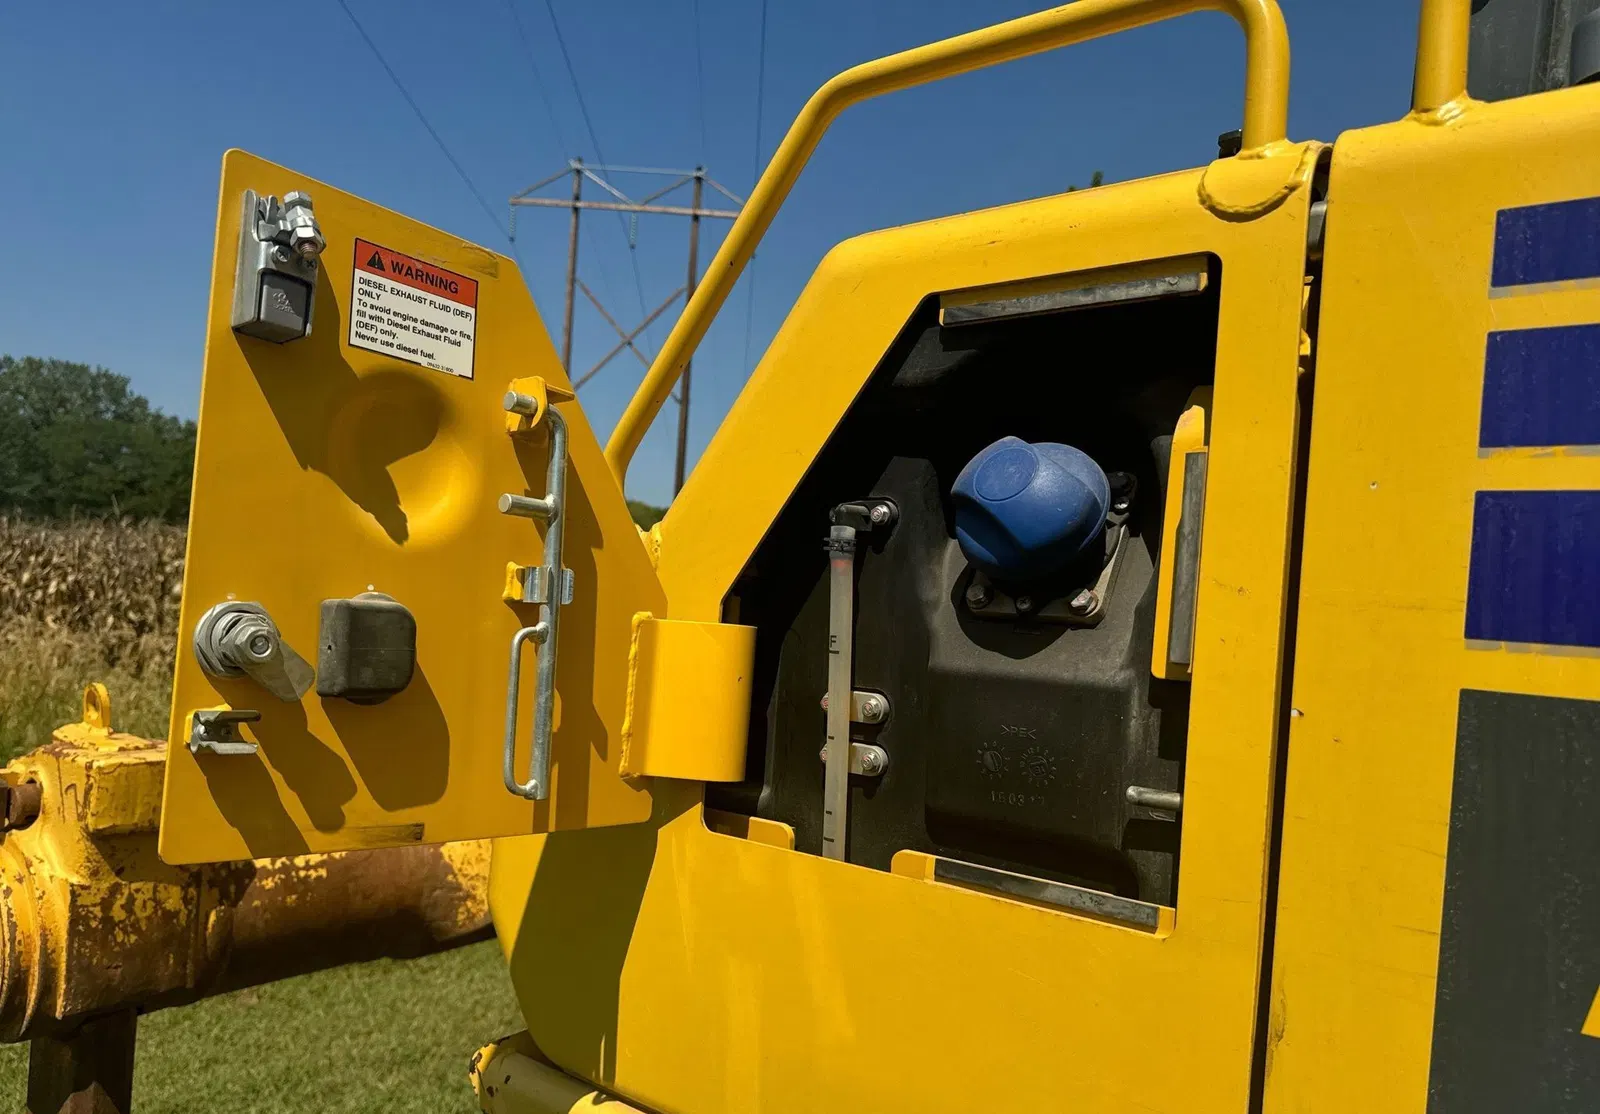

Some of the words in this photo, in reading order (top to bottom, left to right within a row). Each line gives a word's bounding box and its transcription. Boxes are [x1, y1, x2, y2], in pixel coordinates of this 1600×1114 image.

[390, 259, 459, 294] WARNING
[358, 288, 381, 301] ONLY
[358, 276, 388, 293] DIESEL
[390, 287, 428, 305] EXHAUST
[429, 300, 452, 314] FLUID
[452, 307, 473, 322] (DEF)
[355, 319, 378, 334] (DEF)
[380, 328, 399, 340] only.
[356, 309, 367, 319] fill
[368, 313, 385, 325] with
[386, 318, 411, 332] Diesel
[412, 326, 442, 342] Exhaust
[443, 335, 461, 347] Fluid
[357, 298, 368, 308] To
[369, 303, 391, 315] avoid
[392, 309, 418, 324] engine
[420, 318, 449, 334] damage
[450, 328, 458, 336] or
[459, 330, 473, 342] fire,
[355, 330, 378, 344] Never
[380, 338, 395, 349] use
[395, 342, 419, 356] diesel
[420, 349, 436, 361] fuel.
[830, 635, 837, 648] F
